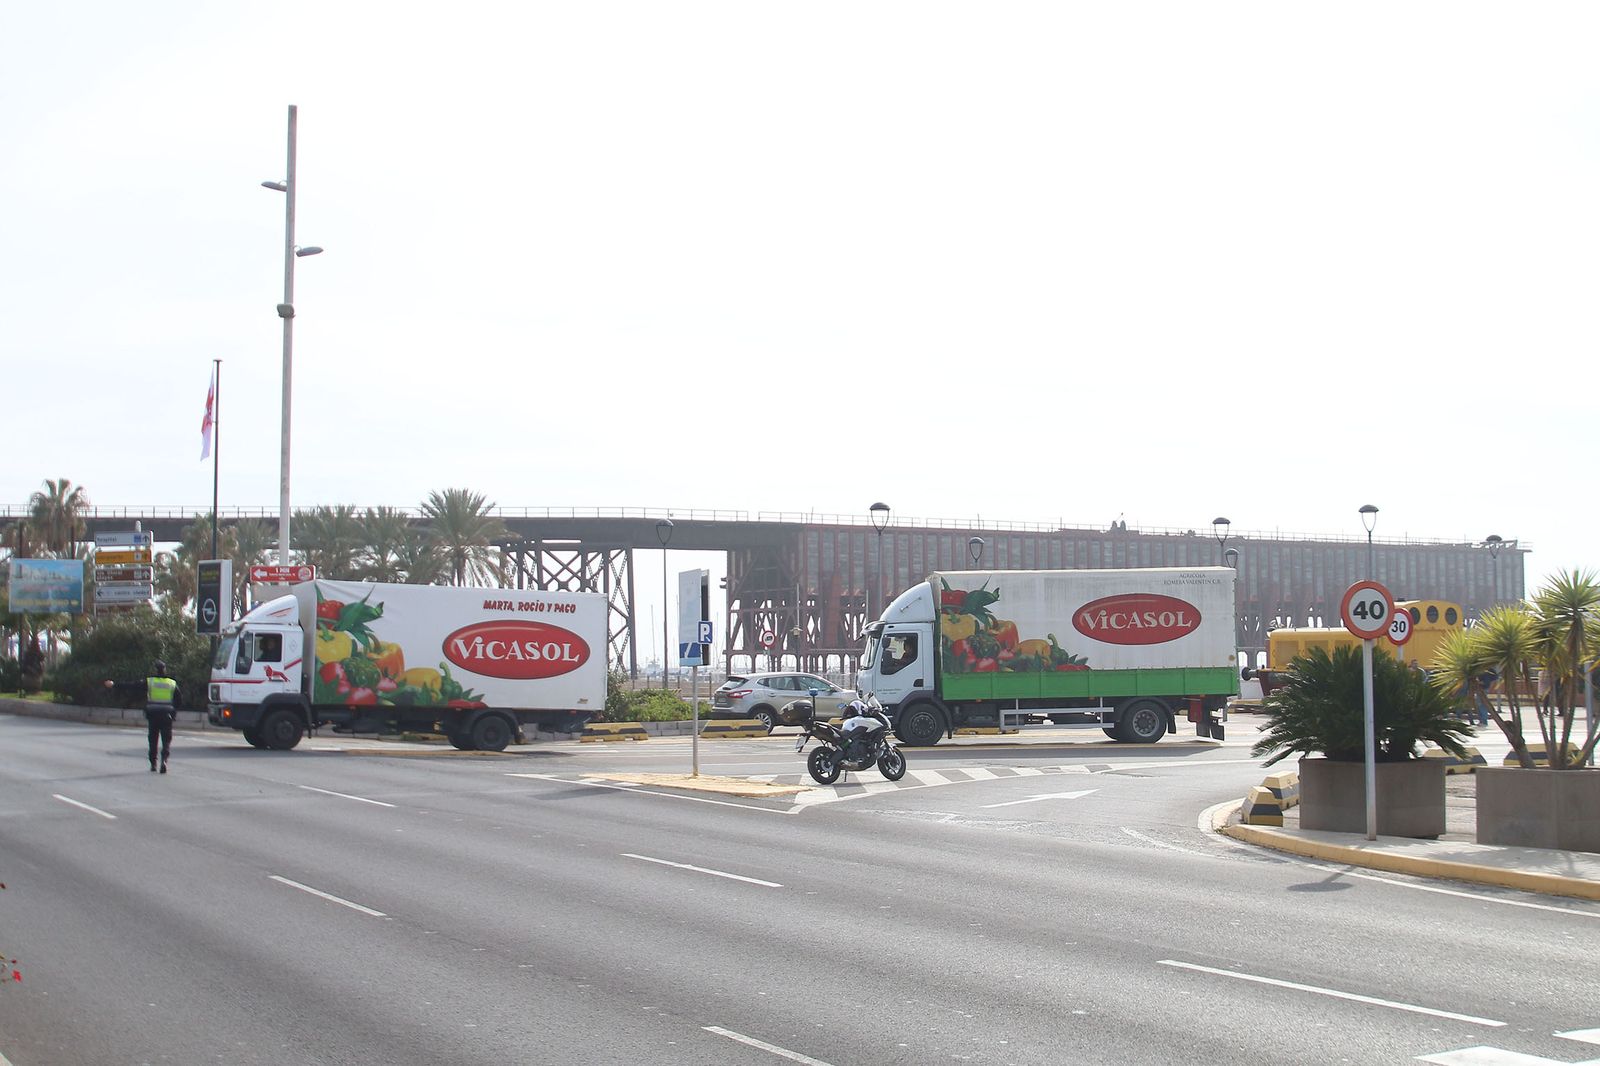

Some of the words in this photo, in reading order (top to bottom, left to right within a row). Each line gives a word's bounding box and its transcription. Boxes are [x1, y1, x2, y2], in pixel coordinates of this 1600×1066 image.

[483, 600, 515, 612] MARTA,
[547, 603, 552, 613] Y
[554, 603, 577, 613] PACO
[1352, 600, 1385, 620] 40
[700, 623, 710, 642] P
[1391, 620, 1407, 633] 30
